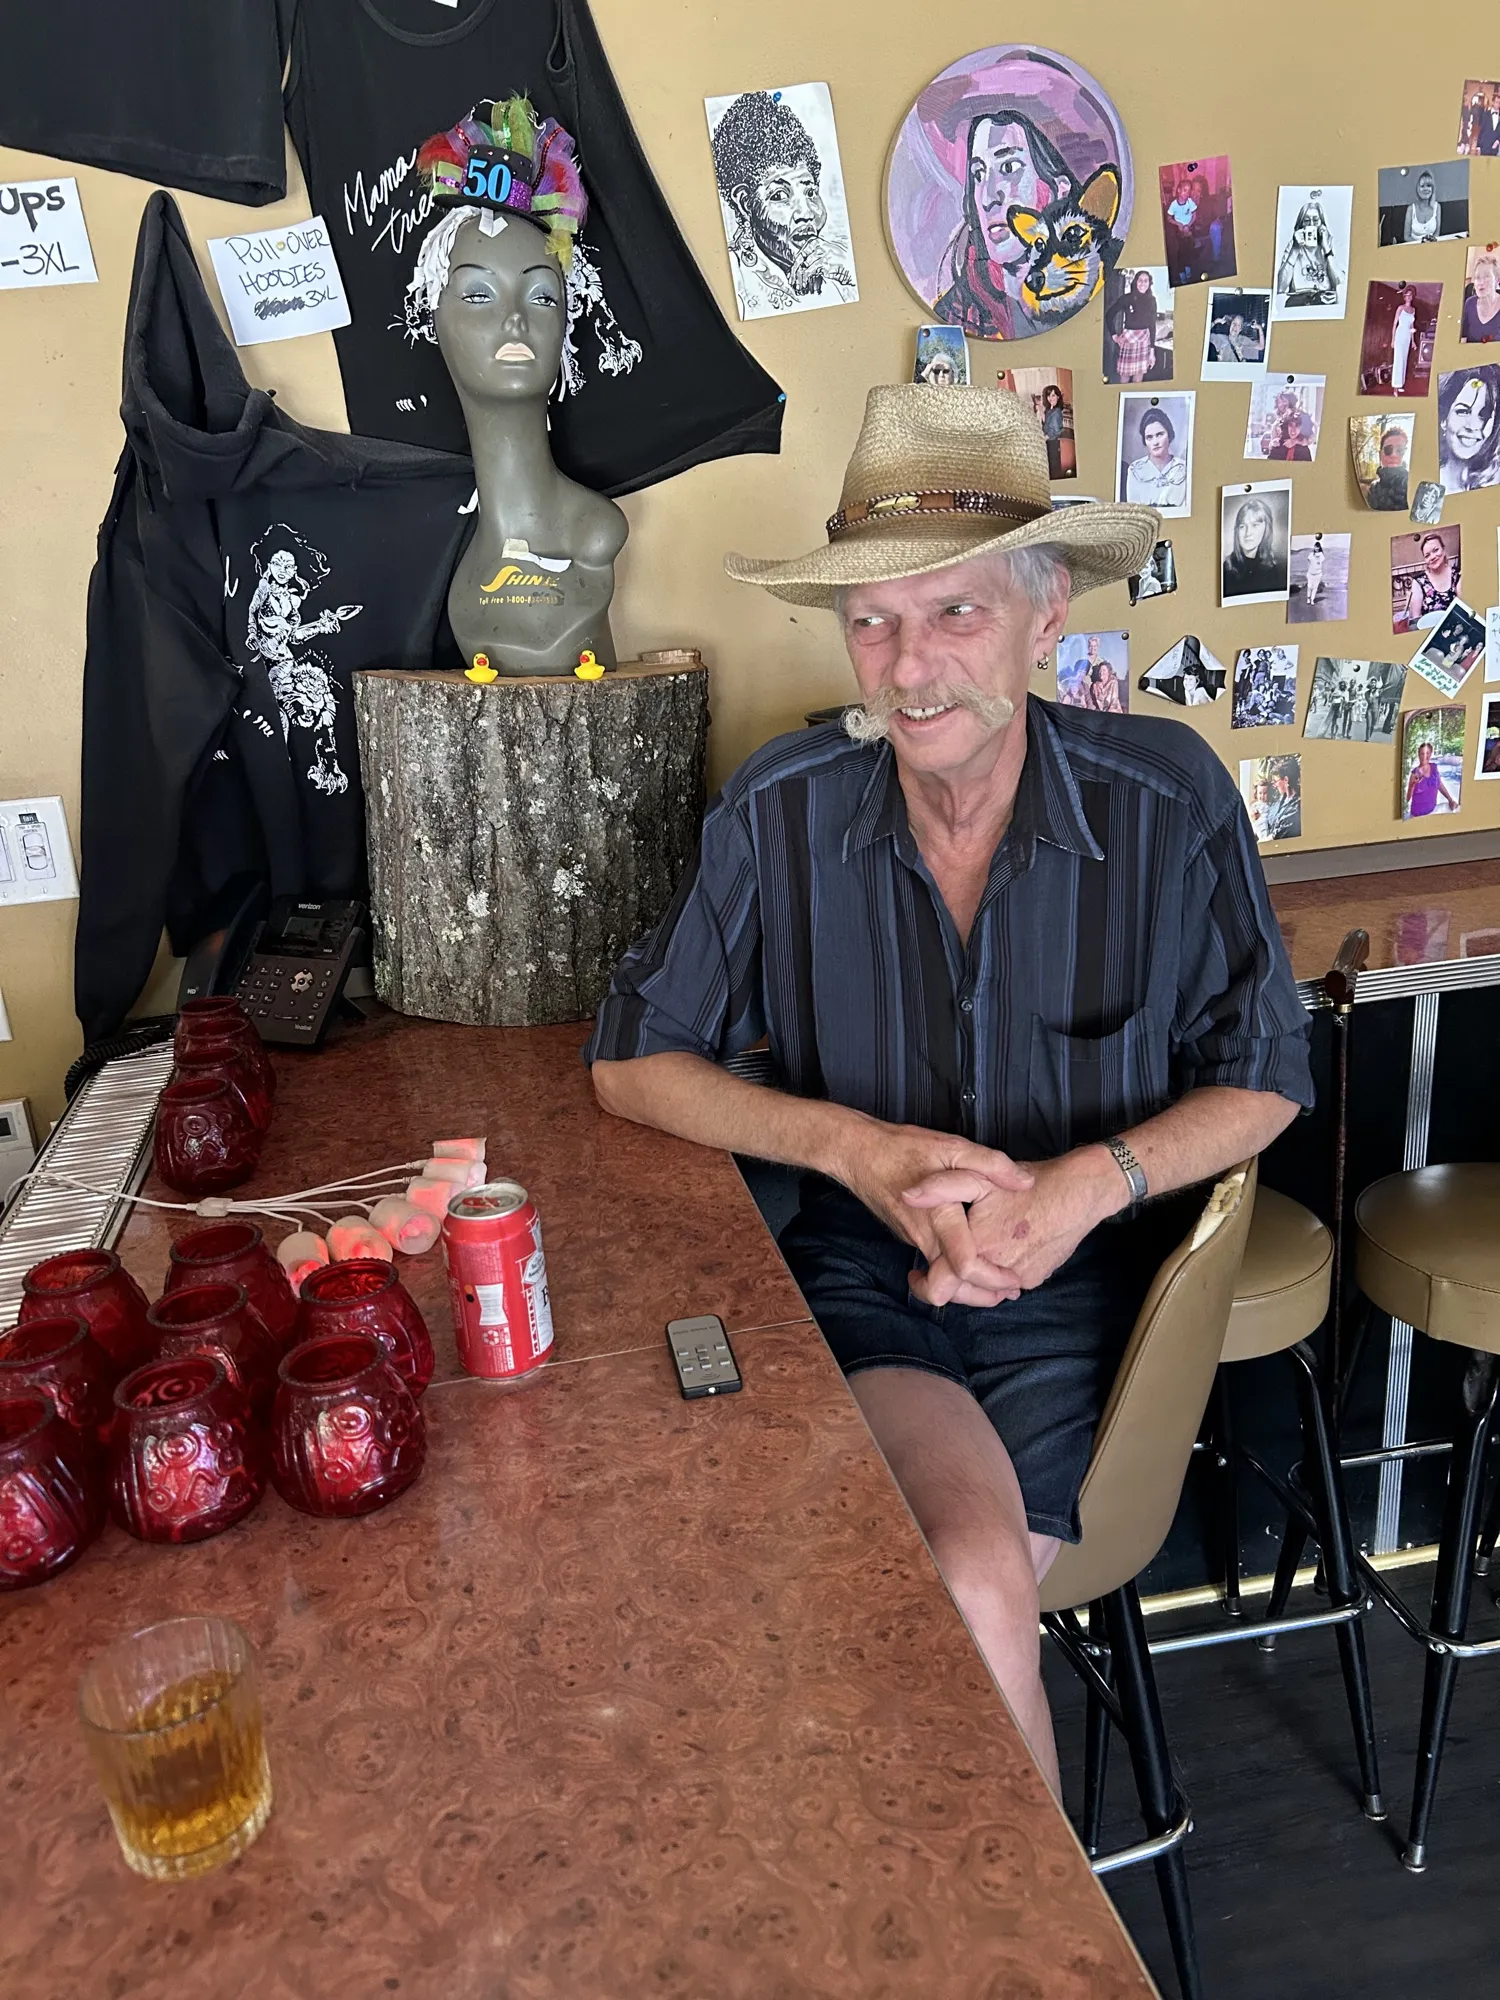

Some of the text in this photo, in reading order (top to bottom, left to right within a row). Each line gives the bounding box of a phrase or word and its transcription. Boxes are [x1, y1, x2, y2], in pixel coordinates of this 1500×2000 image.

[344, 147, 417, 236] Mama
[463, 158, 512, 203] 50
[239, 261, 326, 296] HOODIES
[304, 285, 339, 308] 3XL
[298, 902, 321, 910] verizon
